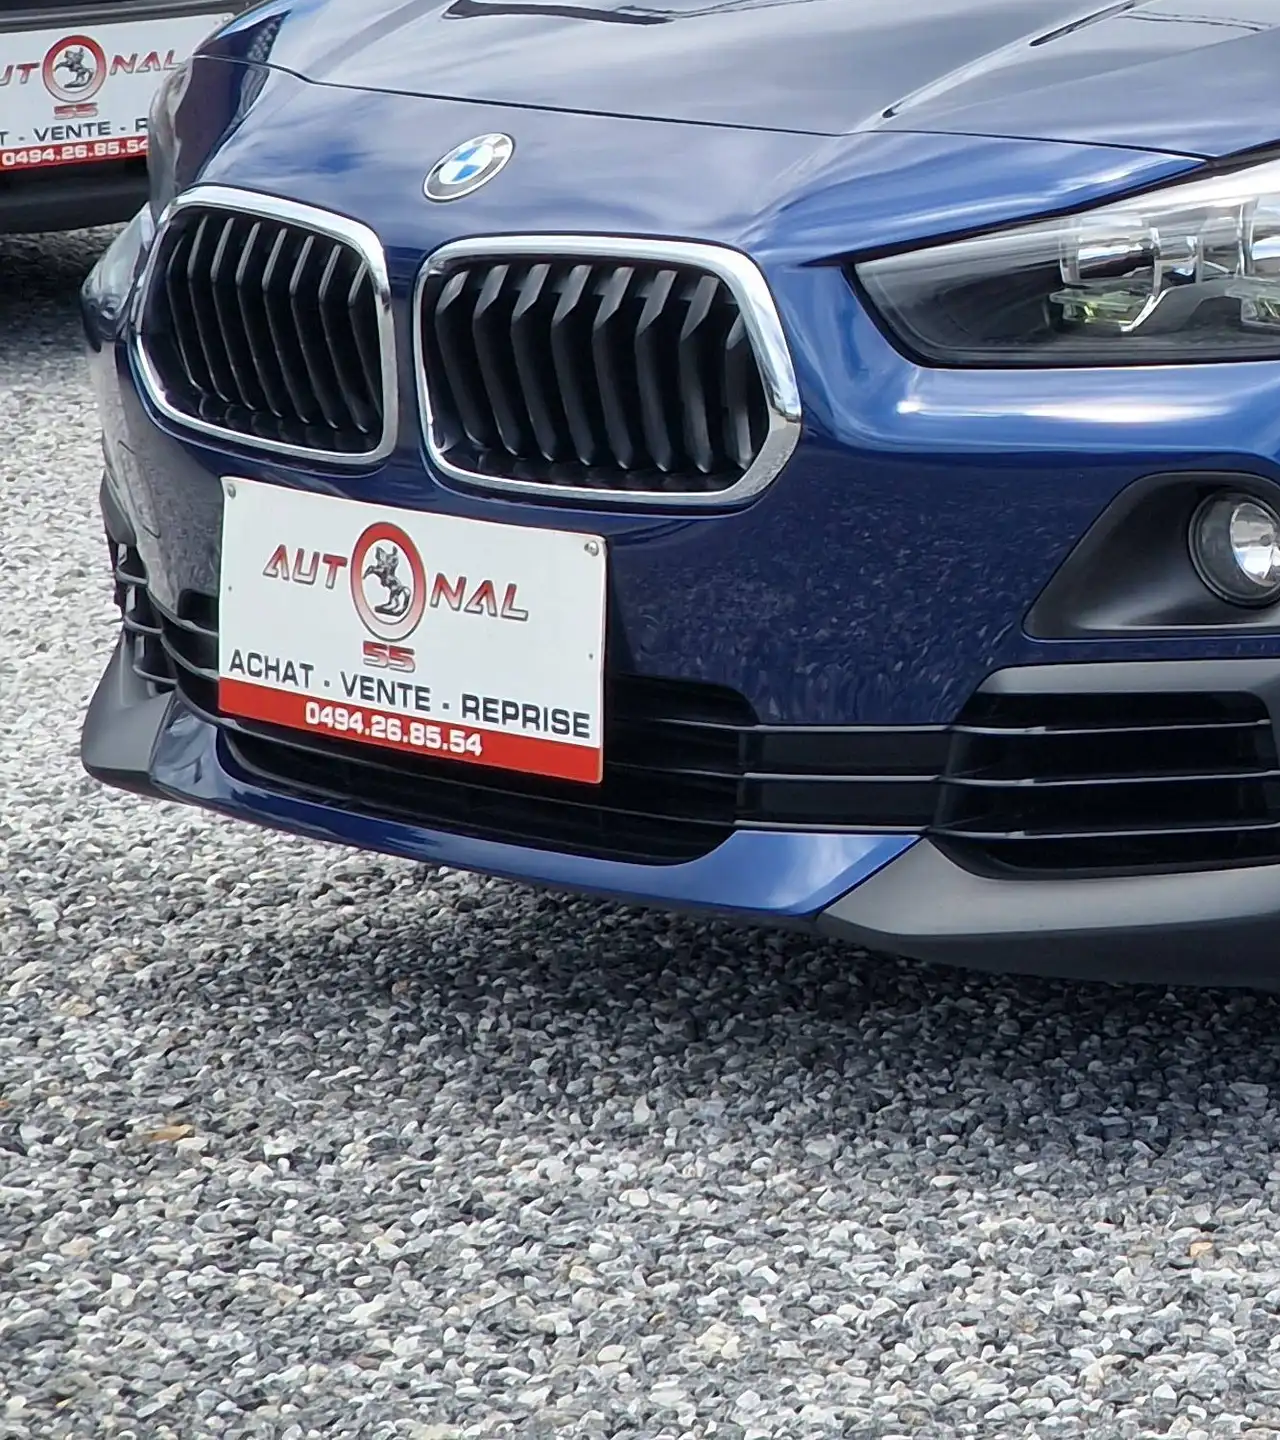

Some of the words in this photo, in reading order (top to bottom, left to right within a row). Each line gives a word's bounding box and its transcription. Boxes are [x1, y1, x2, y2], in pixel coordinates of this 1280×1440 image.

[33, 121, 112, 142] VENTE
[362, 640, 417, 674] 55
[228, 648, 315, 689] ACHAT
[340, 671, 431, 712] VENTE
[461, 693, 591, 739] REPRISE
[304, 701, 483, 757] 0494.26.85.54
